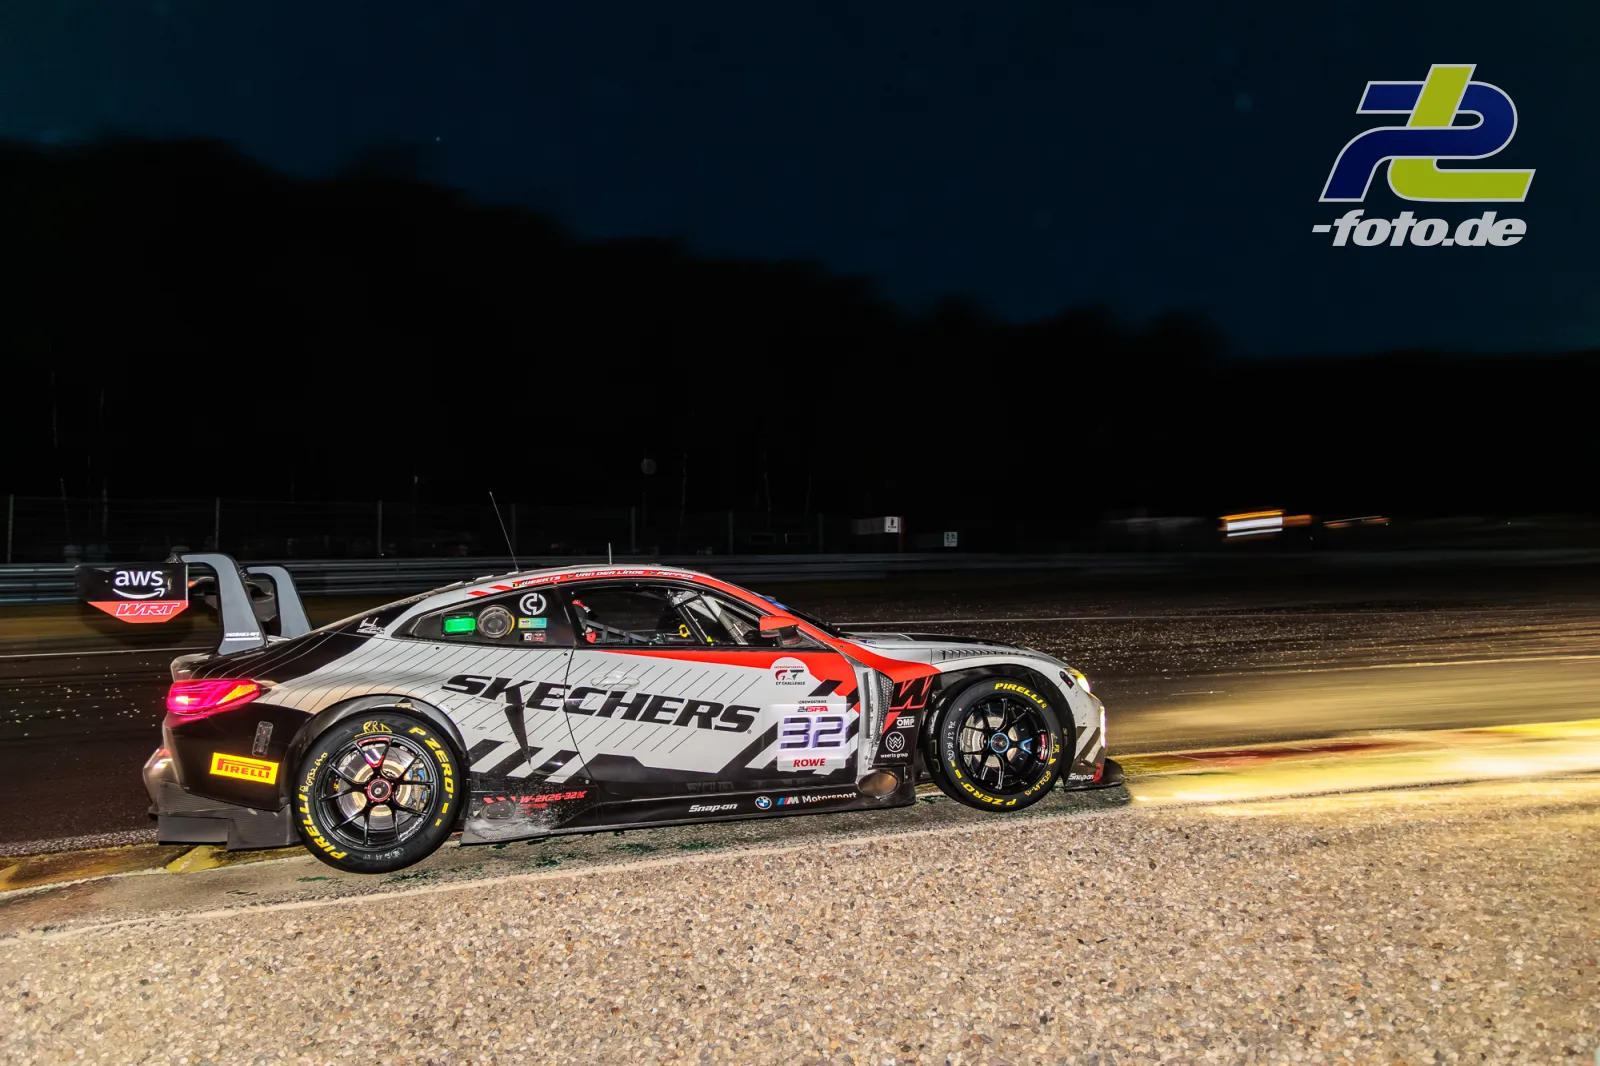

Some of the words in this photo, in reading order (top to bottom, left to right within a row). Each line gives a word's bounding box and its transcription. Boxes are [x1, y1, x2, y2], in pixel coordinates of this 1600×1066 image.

[115, 570, 163, 586] aws
[115, 602, 180, 616] WRT
[994, 682, 1044, 705] PIRELLI
[441, 674, 761, 733] SKECHERS
[896, 717, 915, 728] OMP
[780, 716, 844, 750] 32
[217, 758, 271, 778] PIRELLI
[793, 758, 826, 768] ROWE
[802, 791, 857, 803] Motorsport
[688, 803, 738, 813] Snap-on
[298, 794, 348, 860] PIRELLI
